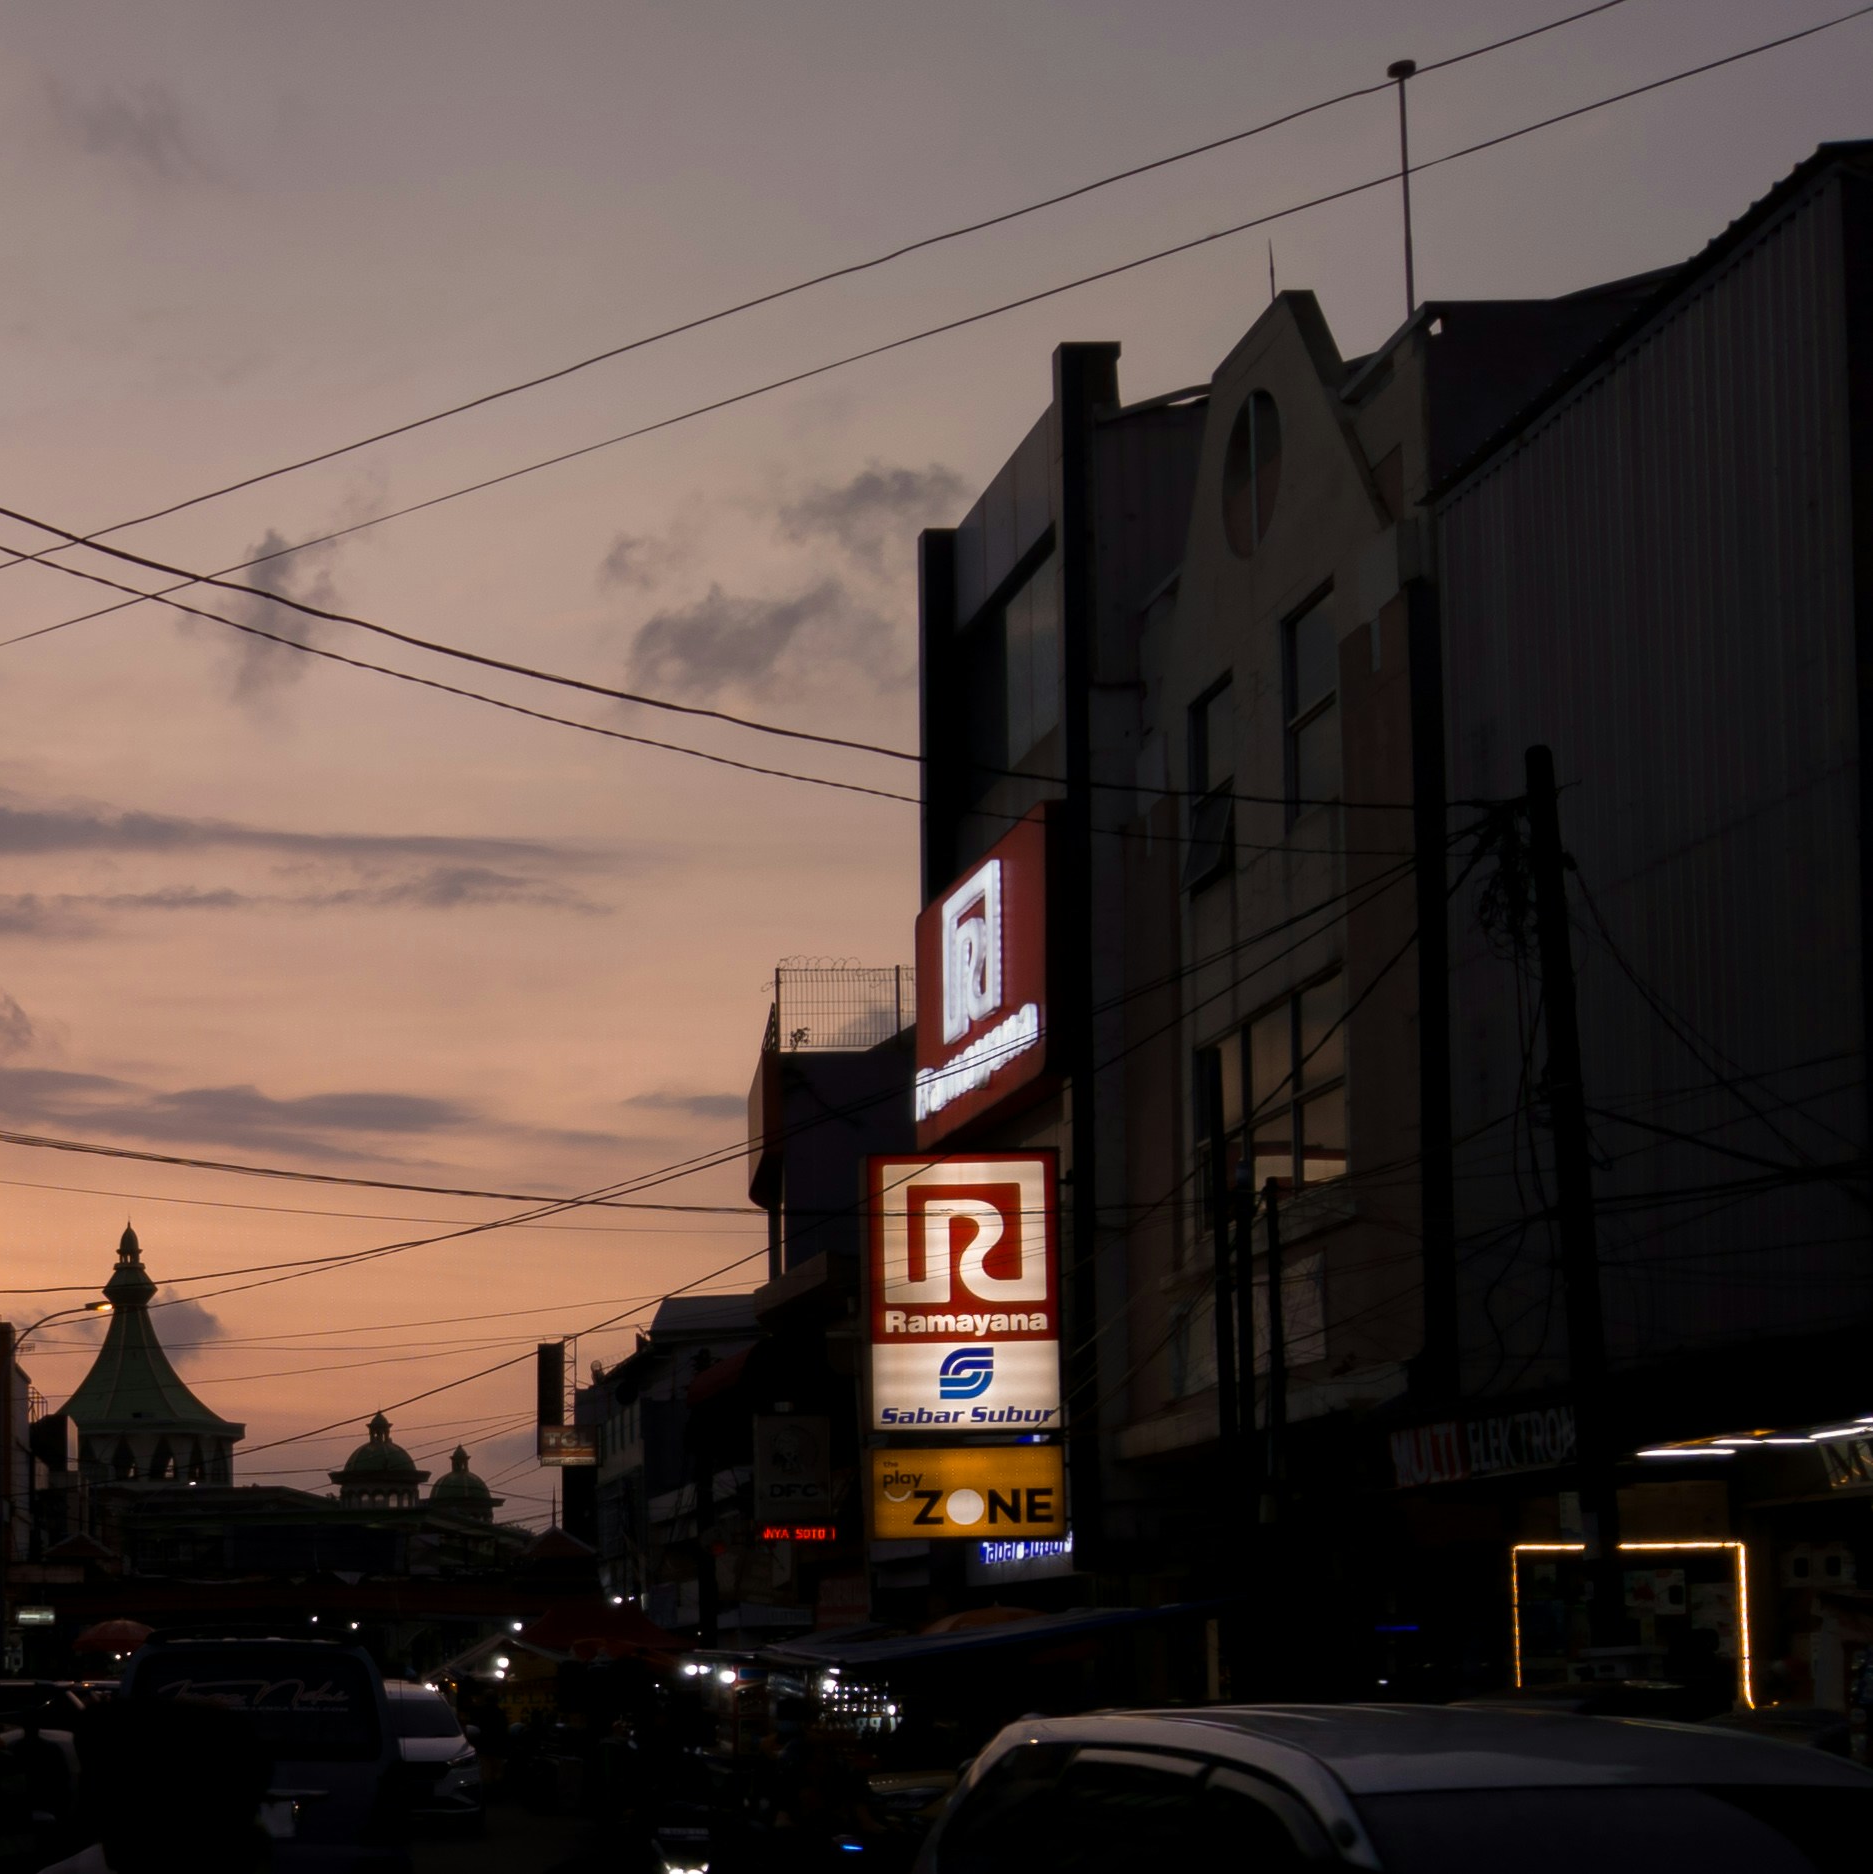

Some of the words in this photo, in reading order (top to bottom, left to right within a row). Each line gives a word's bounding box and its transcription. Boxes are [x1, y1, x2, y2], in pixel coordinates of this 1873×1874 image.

[885, 1310, 1048, 1337] Ramayana
[881, 1407, 966, 1425] Sabar
[971, 1405, 1057, 1423] Subur
[543, 1430, 594, 1447] TCL
[1390, 1421, 1462, 1486] MULTI
[882, 1460, 899, 1468] the
[882, 1470, 923, 1488] play
[770, 1483, 818, 1498] DFC
[913, 1488, 1054, 1526] ZONE
[794, 1526, 826, 1541] SOTO
